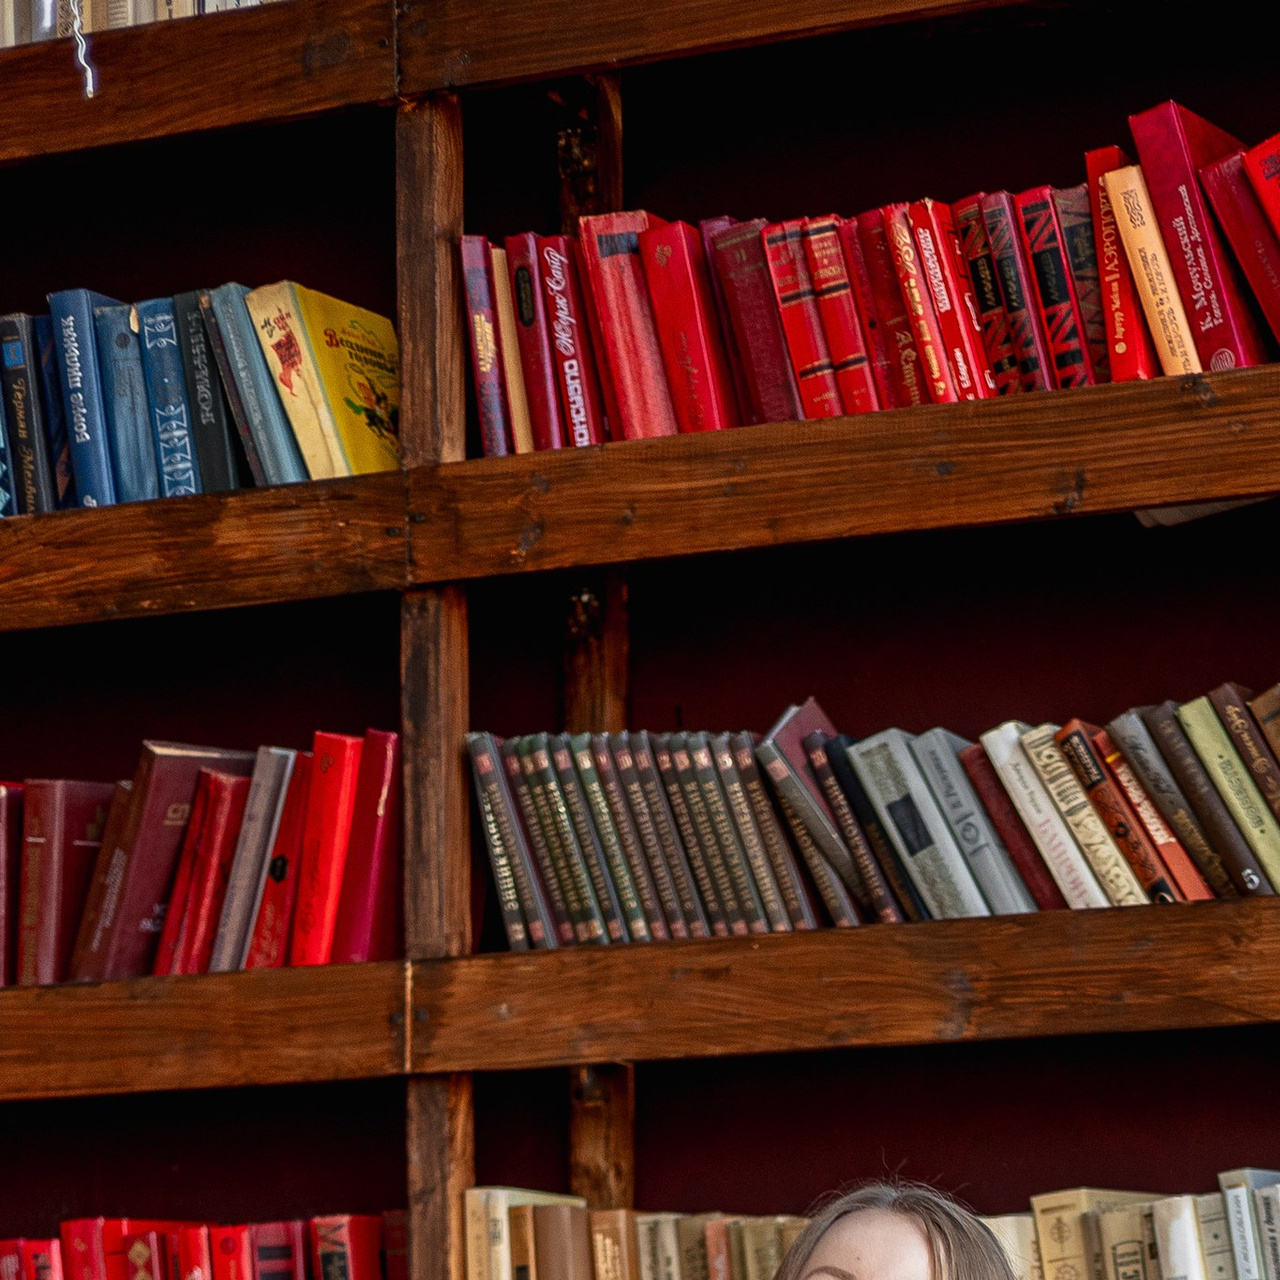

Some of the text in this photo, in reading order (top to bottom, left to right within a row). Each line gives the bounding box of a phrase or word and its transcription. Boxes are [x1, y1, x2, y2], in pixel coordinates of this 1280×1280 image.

[1098, 189, 1119, 272] АЭРОПОРТ
[1172, 215, 1214, 331] К. Мочульский
[544, 247, 576, 356] Жорж Санд
[11, 377, 28, 438] Герман
[61, 315, 90, 443] БОРИС ПИЛЬНЯК
